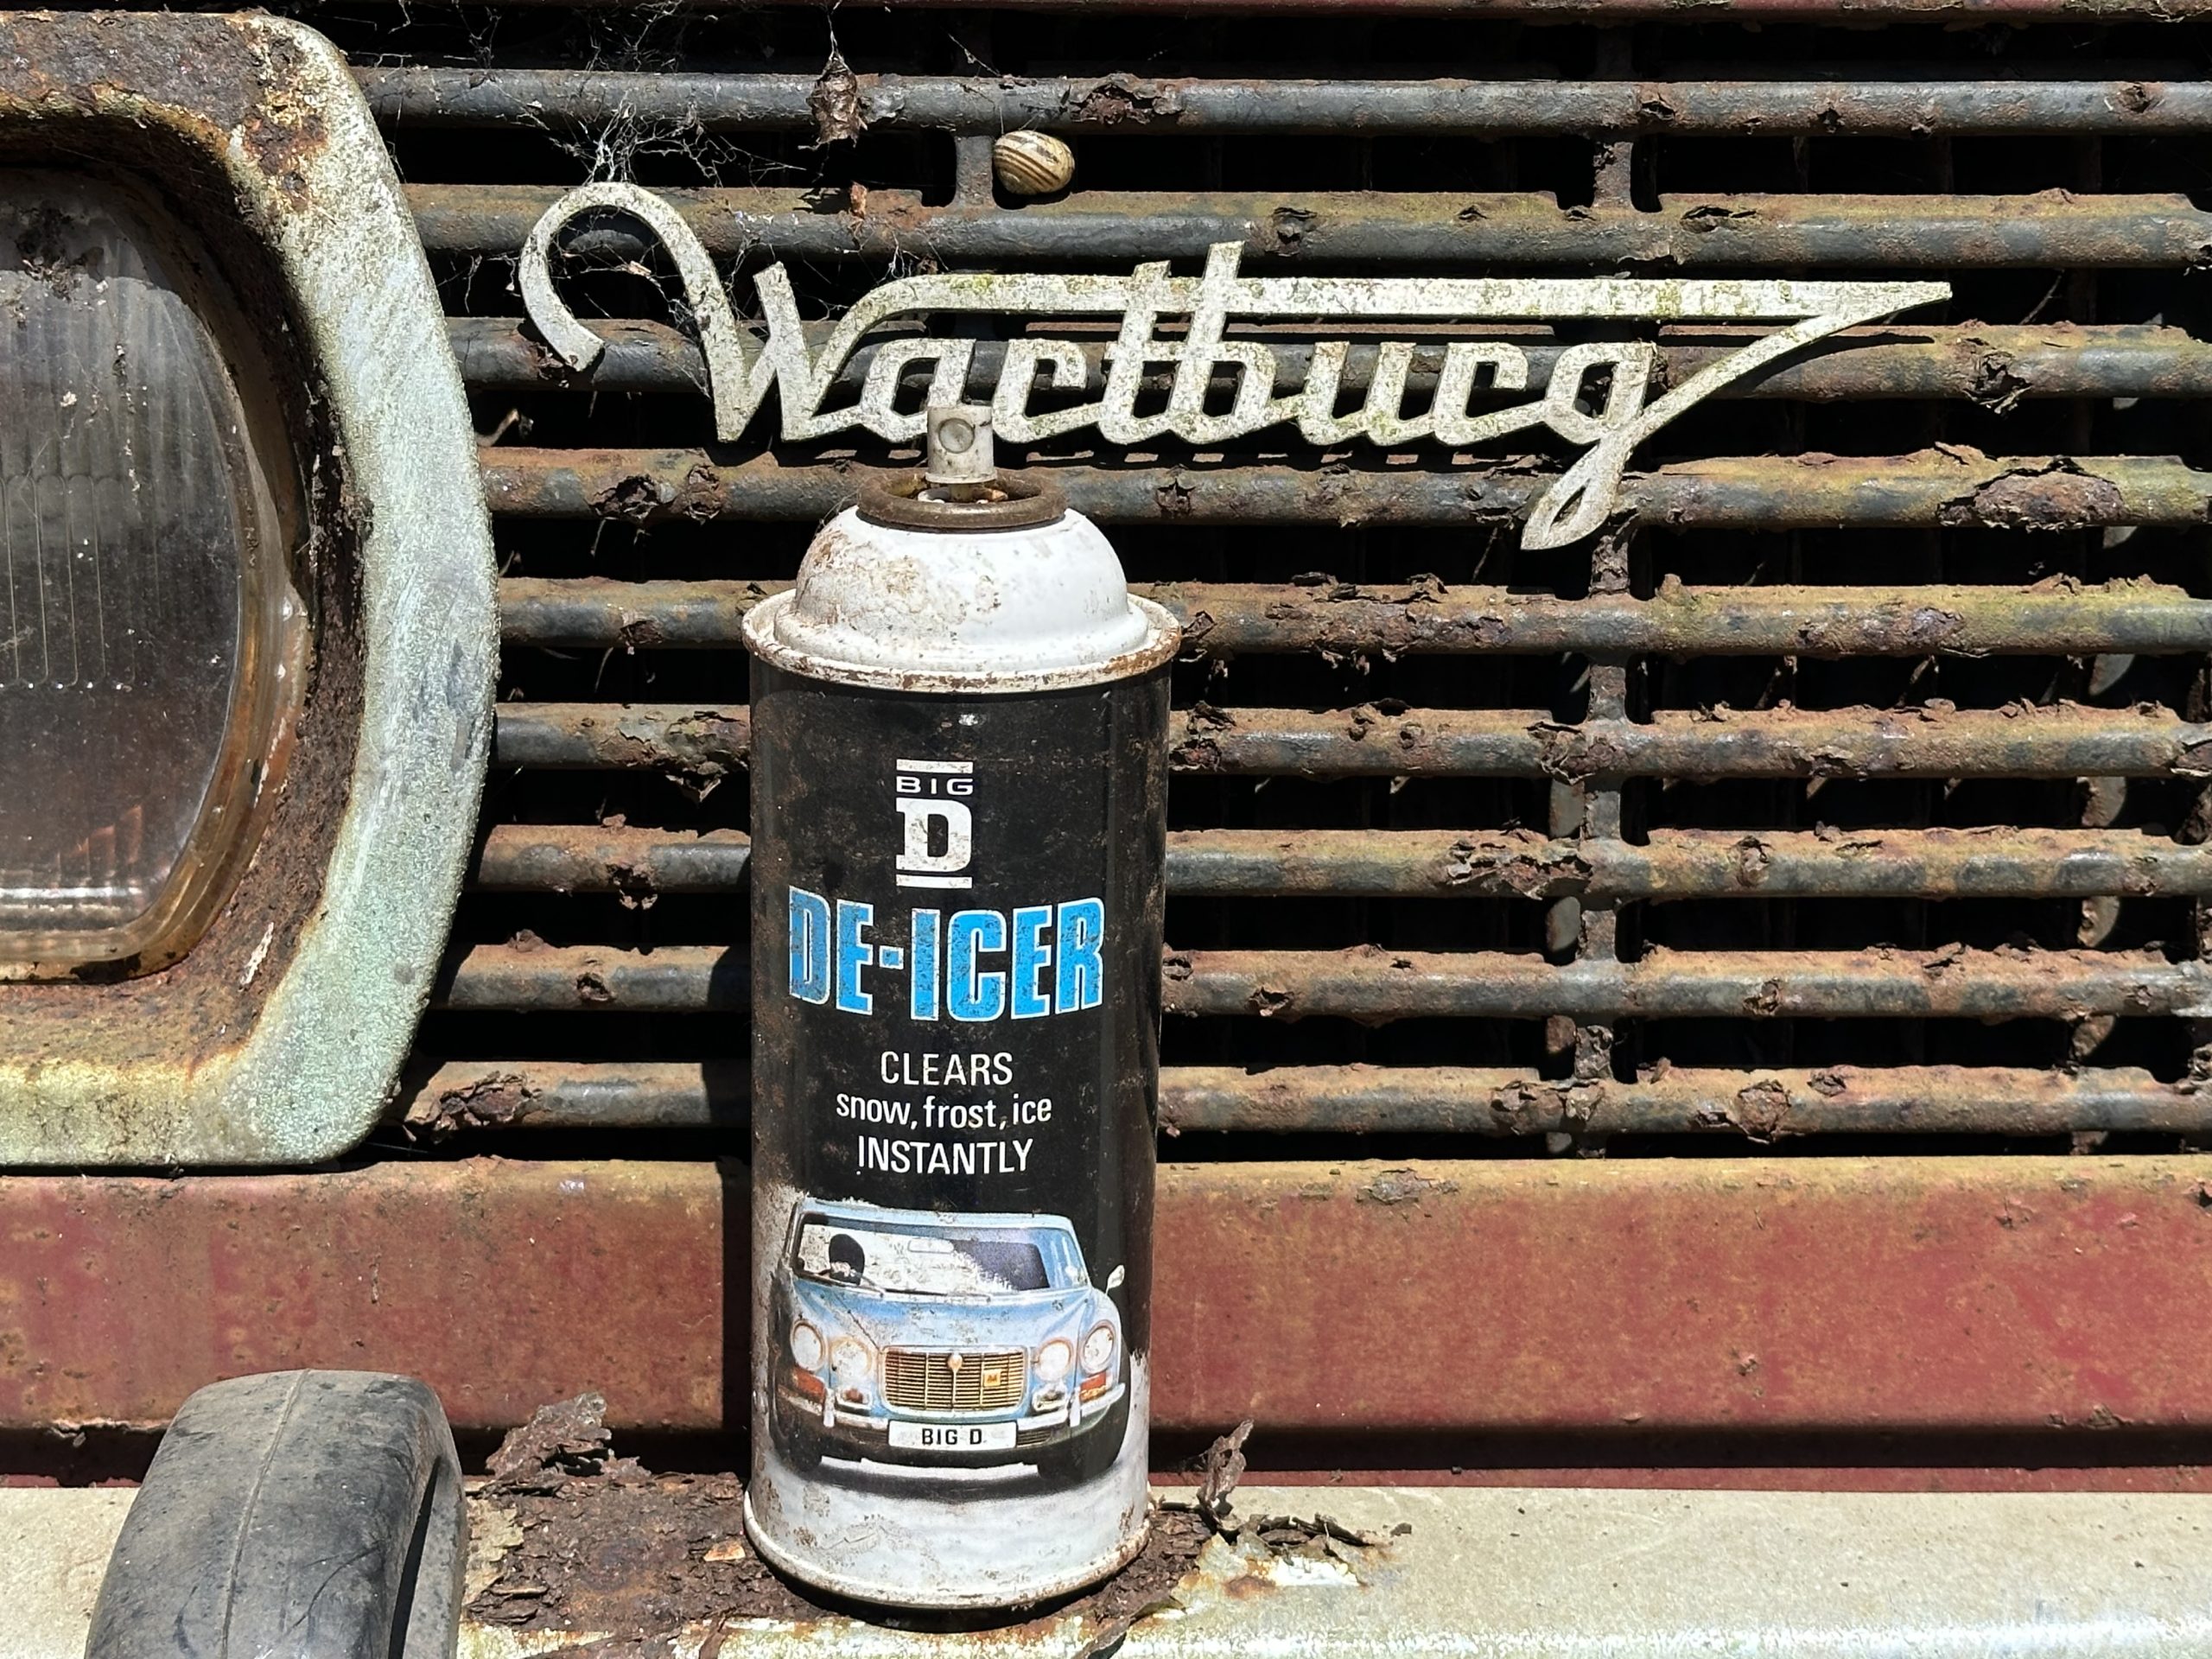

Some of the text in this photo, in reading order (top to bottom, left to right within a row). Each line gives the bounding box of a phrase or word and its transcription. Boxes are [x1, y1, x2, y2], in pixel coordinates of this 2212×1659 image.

[518, 180, 1953, 551] Wartburg
[896, 776, 974, 796] BIG
[895, 797, 972, 873] D
[788, 885, 1105, 1022] DE-ICER
[880, 1051, 1014, 1086] CLEARS
[836, 1093, 1052, 1130] snow, frost, ice
[858, 1135, 1033, 1175] INSTANTLY
[921, 1427, 982, 1446] BIG D
